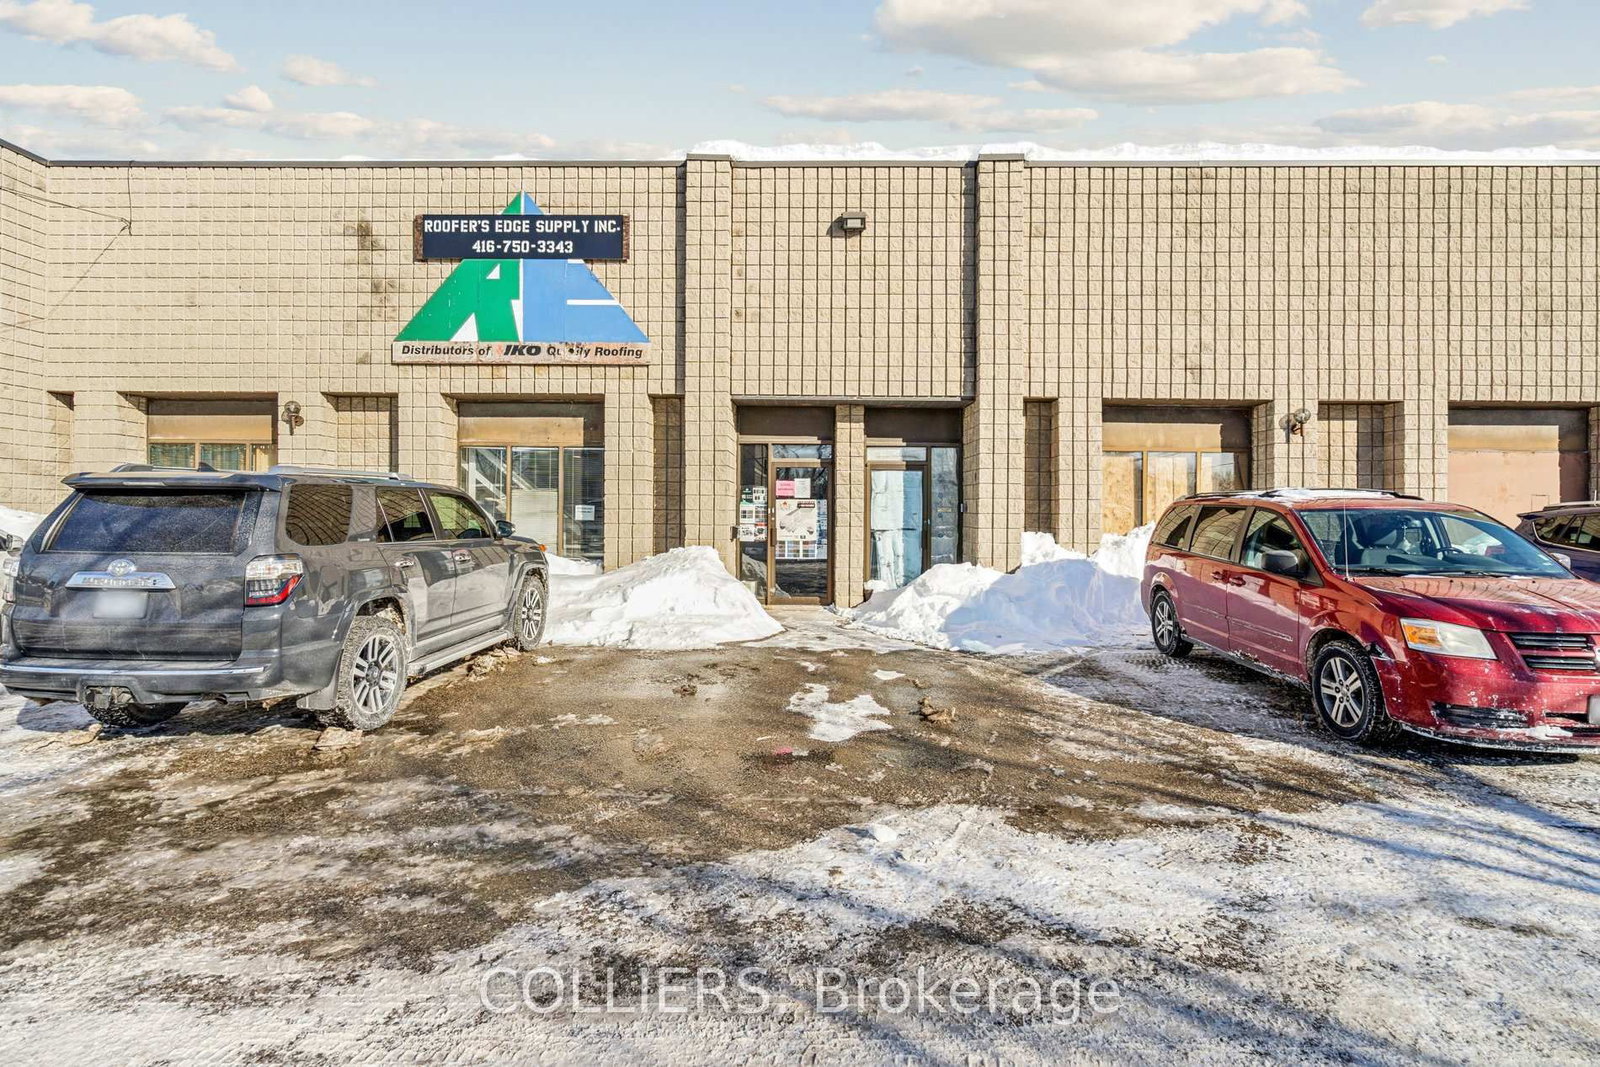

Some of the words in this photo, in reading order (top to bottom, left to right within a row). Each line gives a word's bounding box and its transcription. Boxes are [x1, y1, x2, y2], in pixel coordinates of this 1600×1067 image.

[424, 219, 490, 233] ROOFER'S
[495, 219, 531, 233] EDGE
[535, 219, 589, 233] SUPPLY
[472, 240, 574, 254] 416-750-3343
[402, 345, 474, 356] Distributors
[478, 345, 493, 357] of
[504, 345, 541, 356] IKO
[594, 347, 643, 358] Roofing
